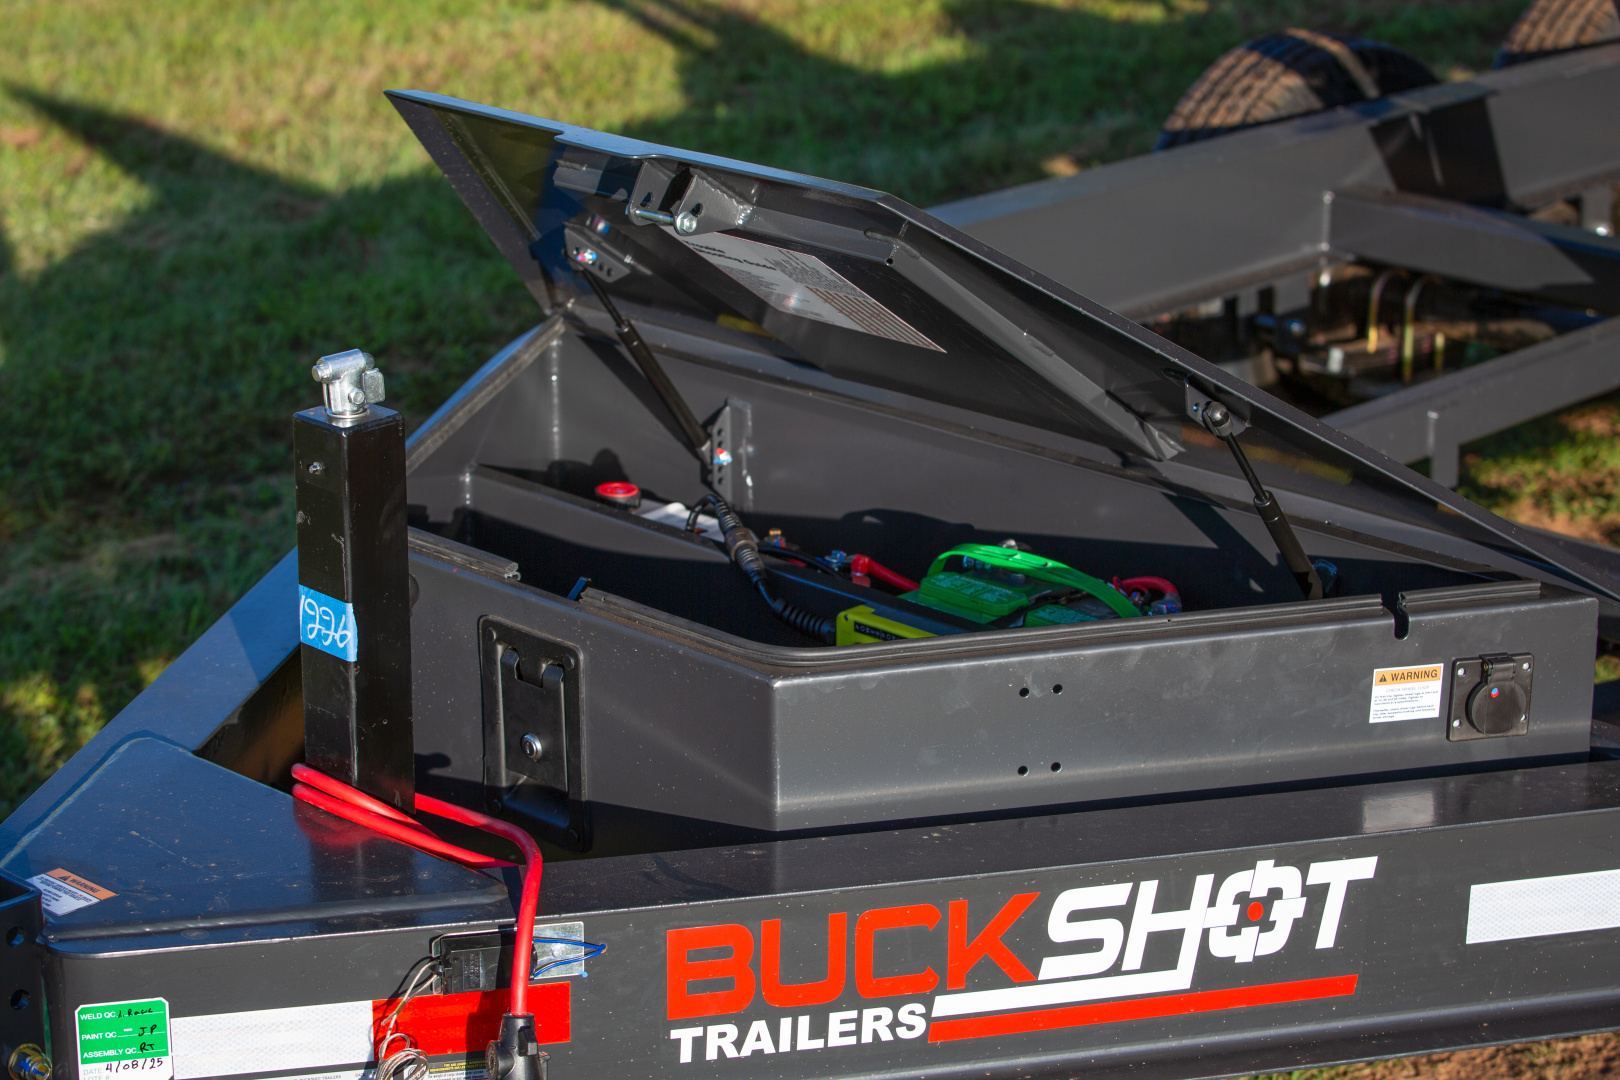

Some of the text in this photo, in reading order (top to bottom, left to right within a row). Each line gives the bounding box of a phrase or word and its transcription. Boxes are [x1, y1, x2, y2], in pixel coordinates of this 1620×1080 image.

[1391, 669, 1438, 682] WARNING
[80, 1011, 116, 1020] WELD QC
[81, 1031, 117, 1040] PAINT QC
[670, 1003, 927, 1064] TRAILERS
[83, 1047, 137, 1059] ASSEMBLY QC
[105, 1057, 163, 1073] 4/08/25
